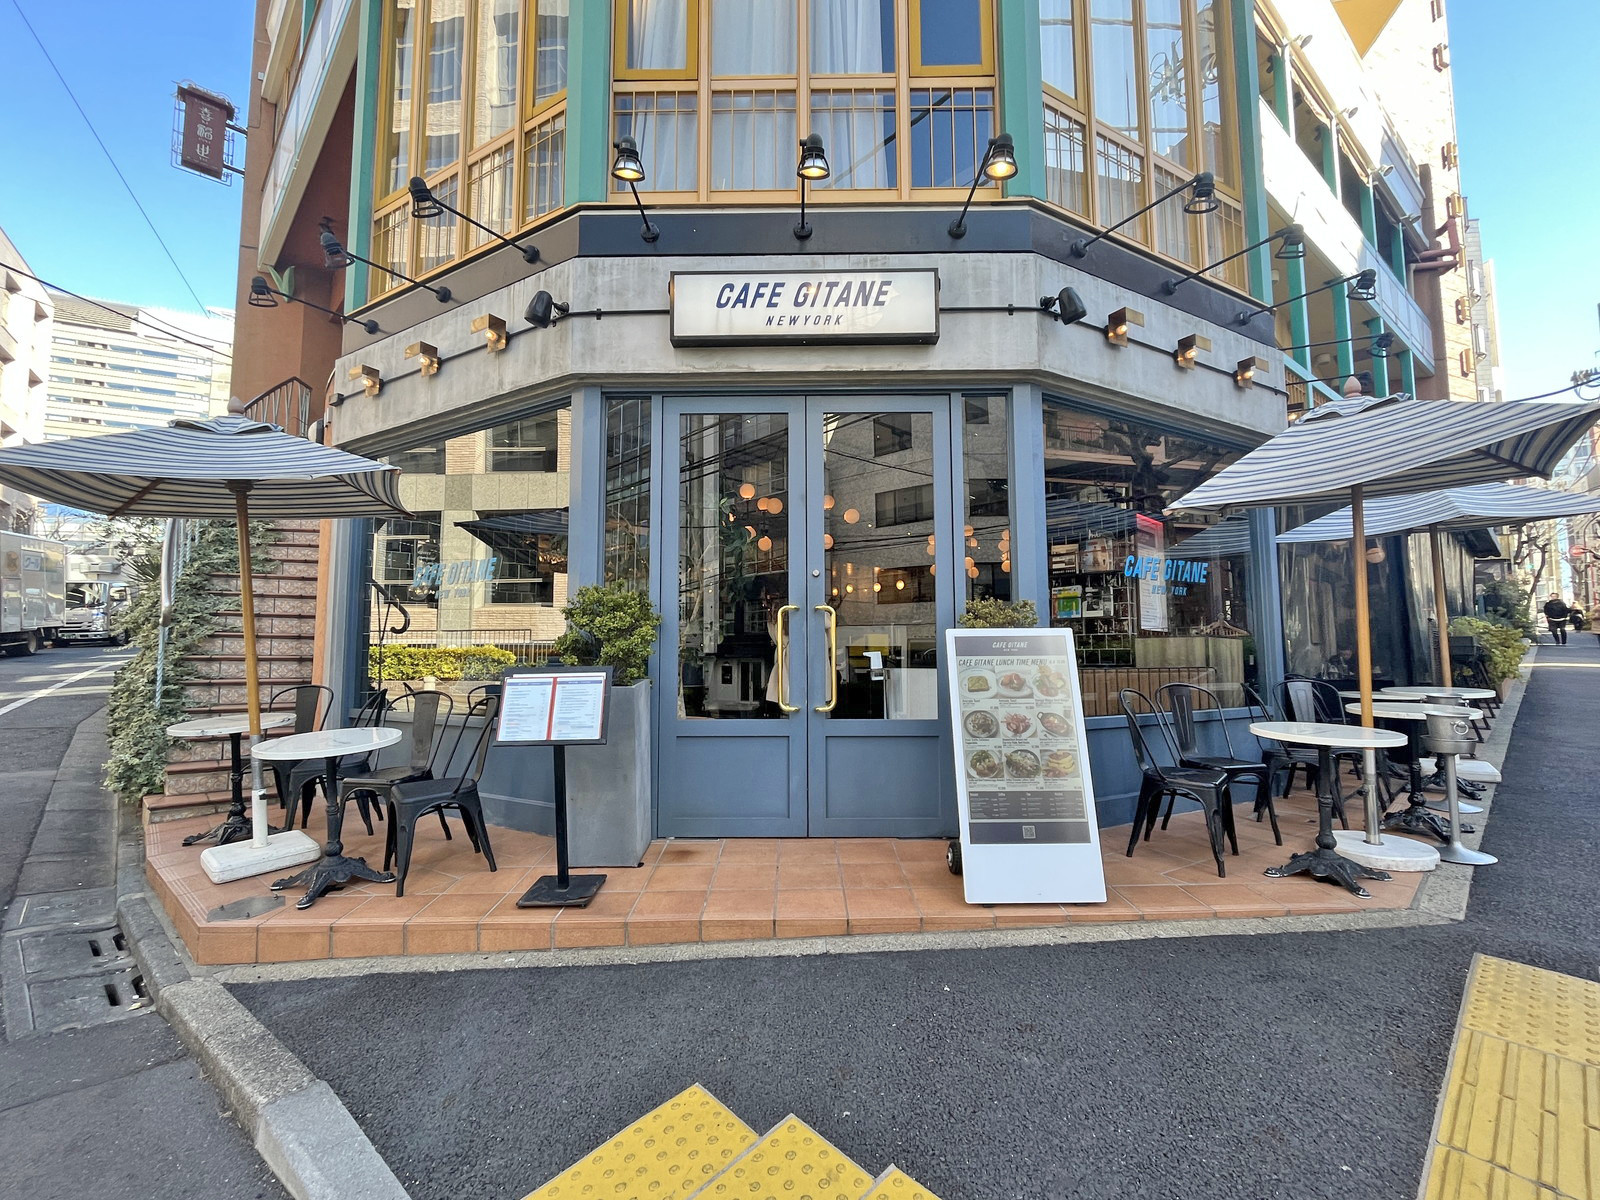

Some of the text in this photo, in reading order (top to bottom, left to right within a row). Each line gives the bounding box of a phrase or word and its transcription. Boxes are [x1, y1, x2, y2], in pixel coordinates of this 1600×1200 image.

[716, 280, 892, 309] CAFE GITANE
[1124, 555, 1209, 583] CAFE GITANE
[1151, 584, 1188, 596] NEW YORK
[1007, 641, 1029, 649] GITANE
[958, 659, 973, 667] CAFE
[973, 659, 995, 667] GITANE
